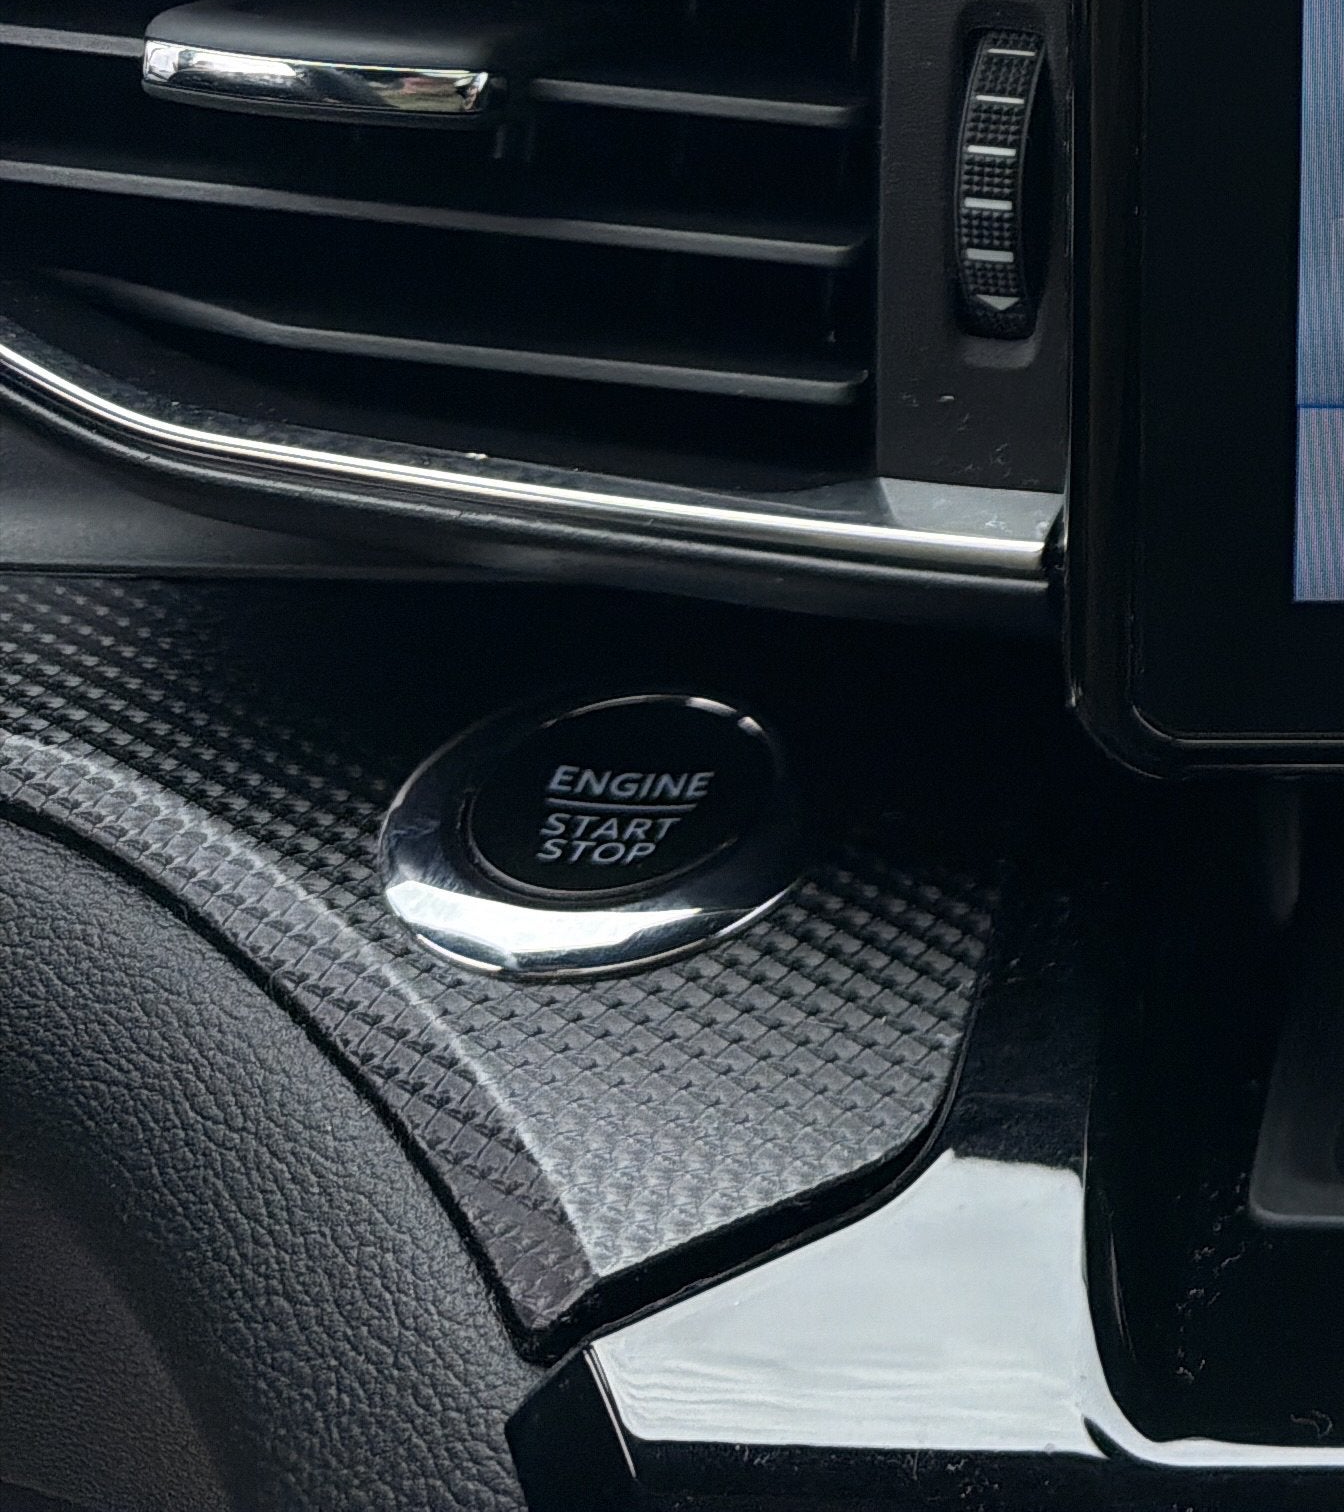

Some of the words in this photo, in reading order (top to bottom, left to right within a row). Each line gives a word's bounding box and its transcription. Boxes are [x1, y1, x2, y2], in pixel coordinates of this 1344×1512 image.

[546, 764, 715, 800] ENGINE
[539, 813, 681, 841] START
[536, 838, 658, 865] STOP
